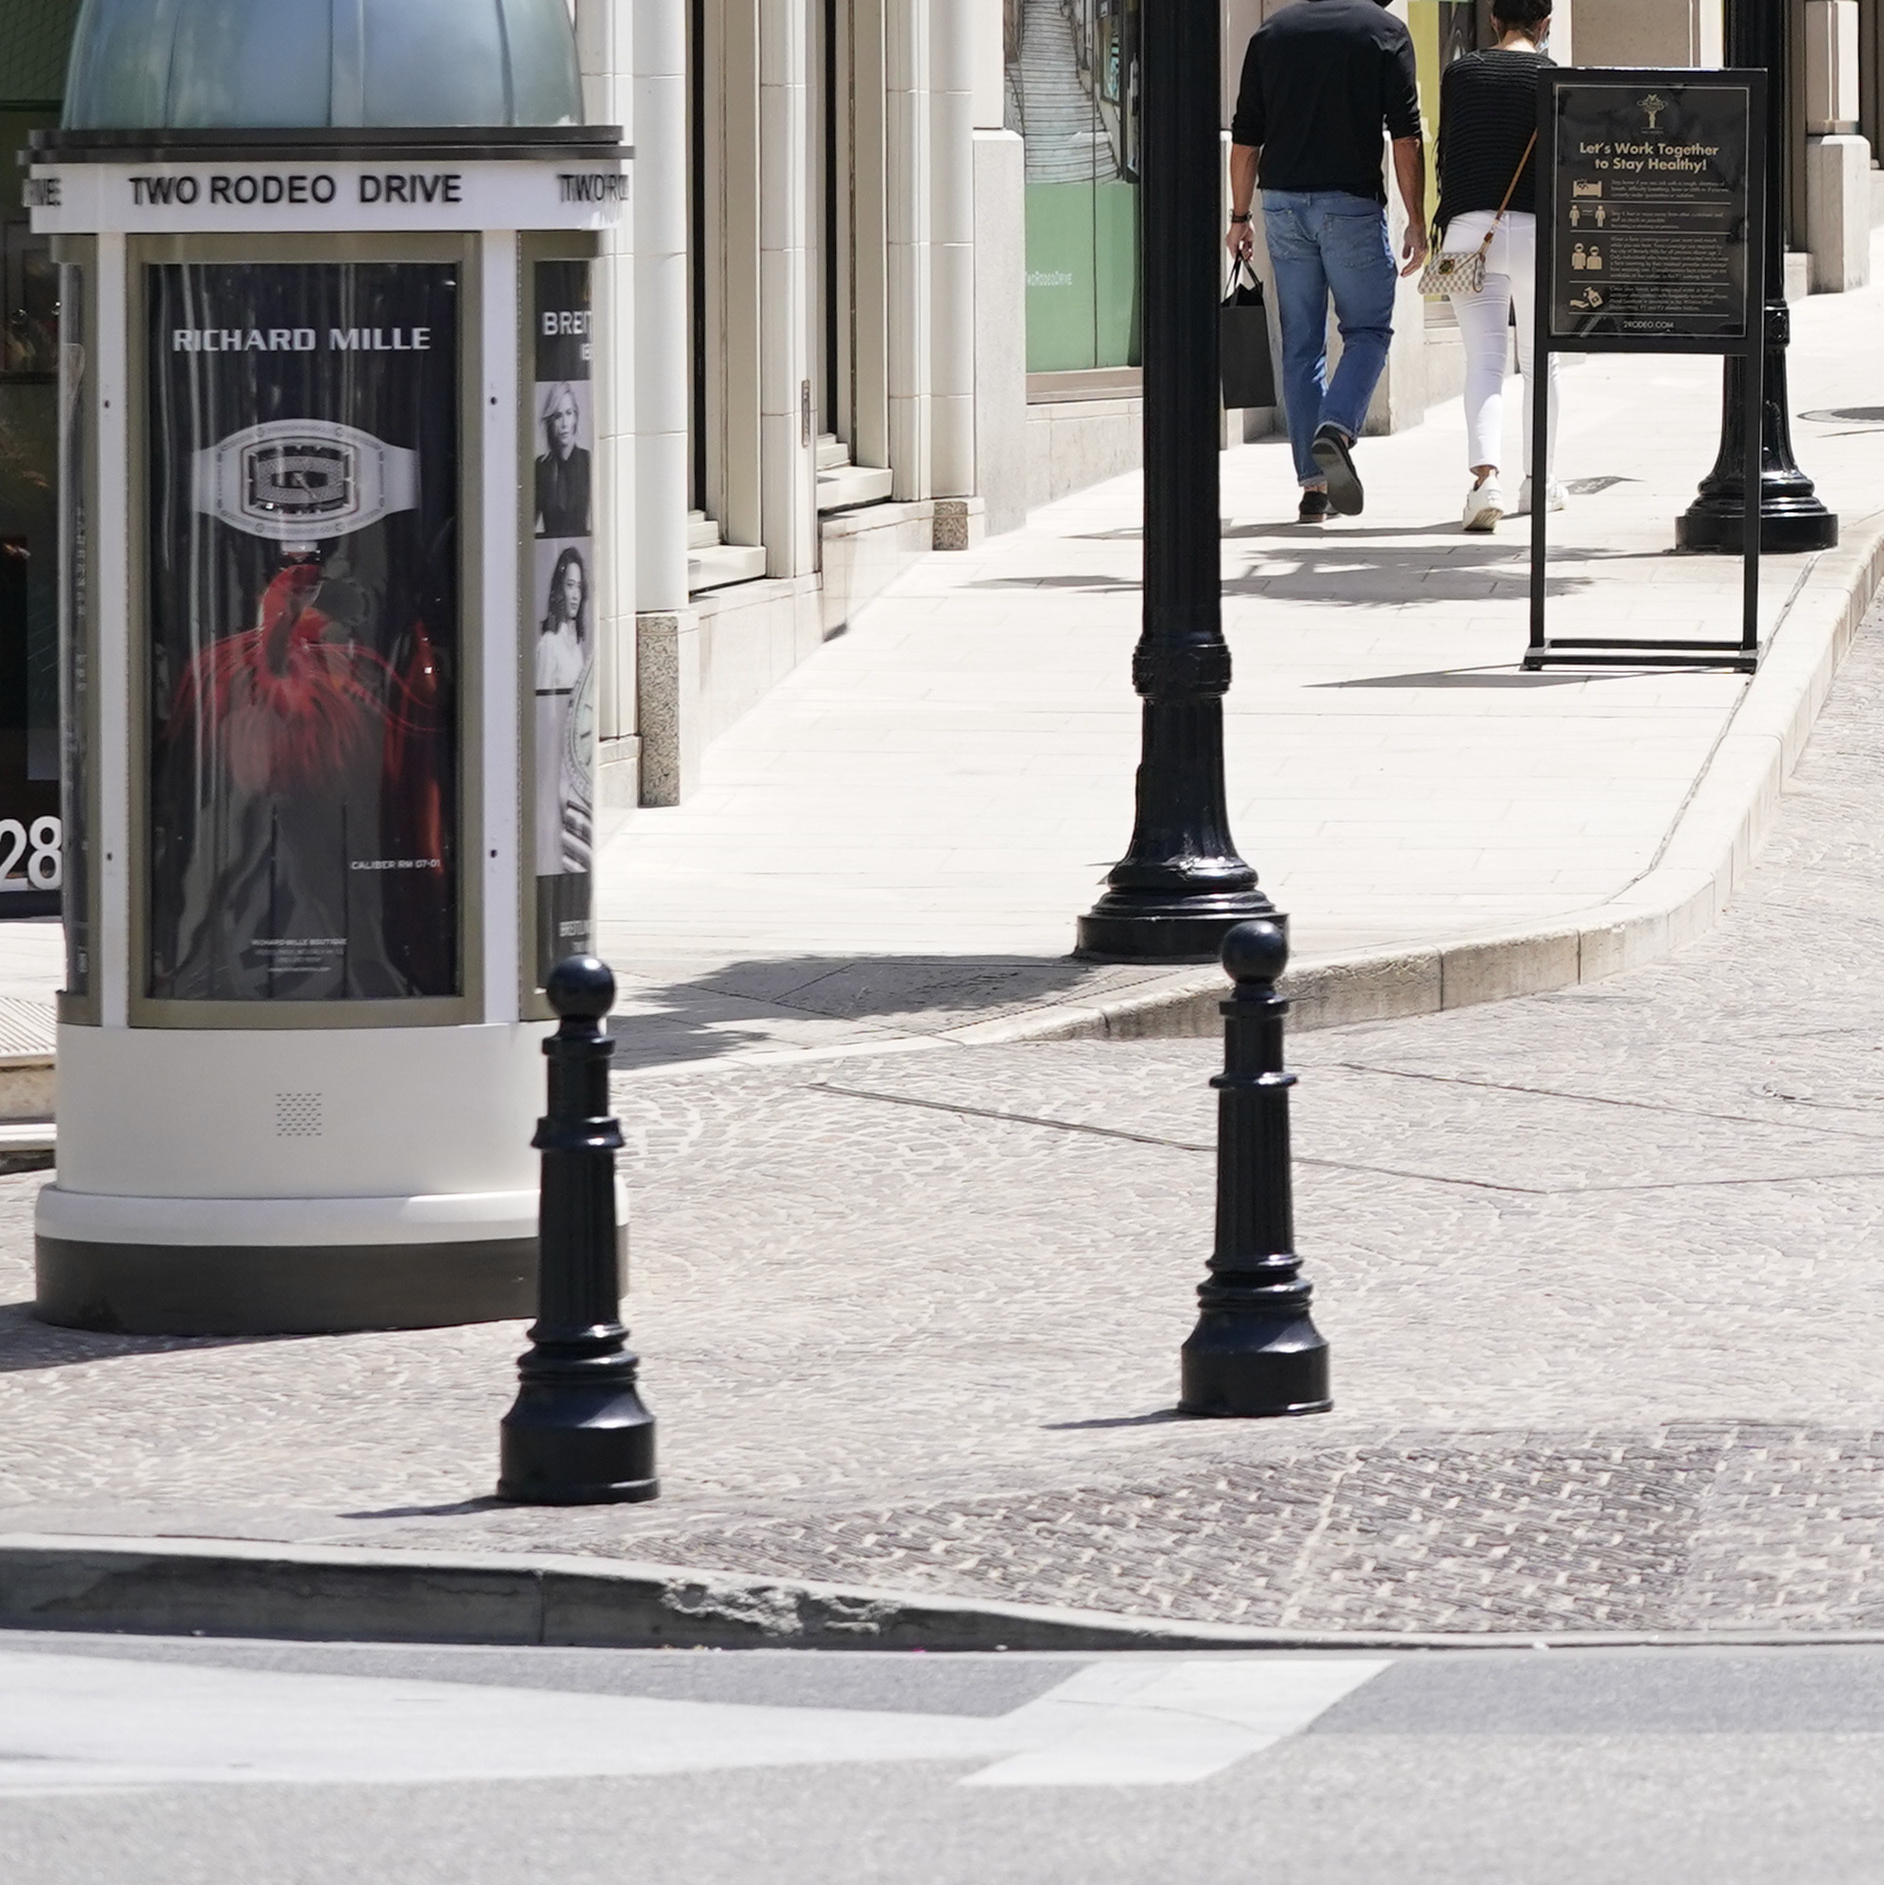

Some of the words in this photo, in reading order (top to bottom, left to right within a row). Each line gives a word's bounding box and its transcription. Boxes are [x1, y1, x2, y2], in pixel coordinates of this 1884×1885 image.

[1615, 141, 1654, 155] Work
[1657, 142, 1719, 158] Together
[1594, 157, 1610, 170] to
[1612, 157, 1644, 173] Stay
[1648, 158, 1707, 174] Healthy!
[129, 175, 201, 206] TWO
[210, 174, 337, 206] RODEO
[358, 174, 464, 204] DRIVE
[173, 328, 317, 355] RICHARD
[328, 326, 432, 352] MILLE
